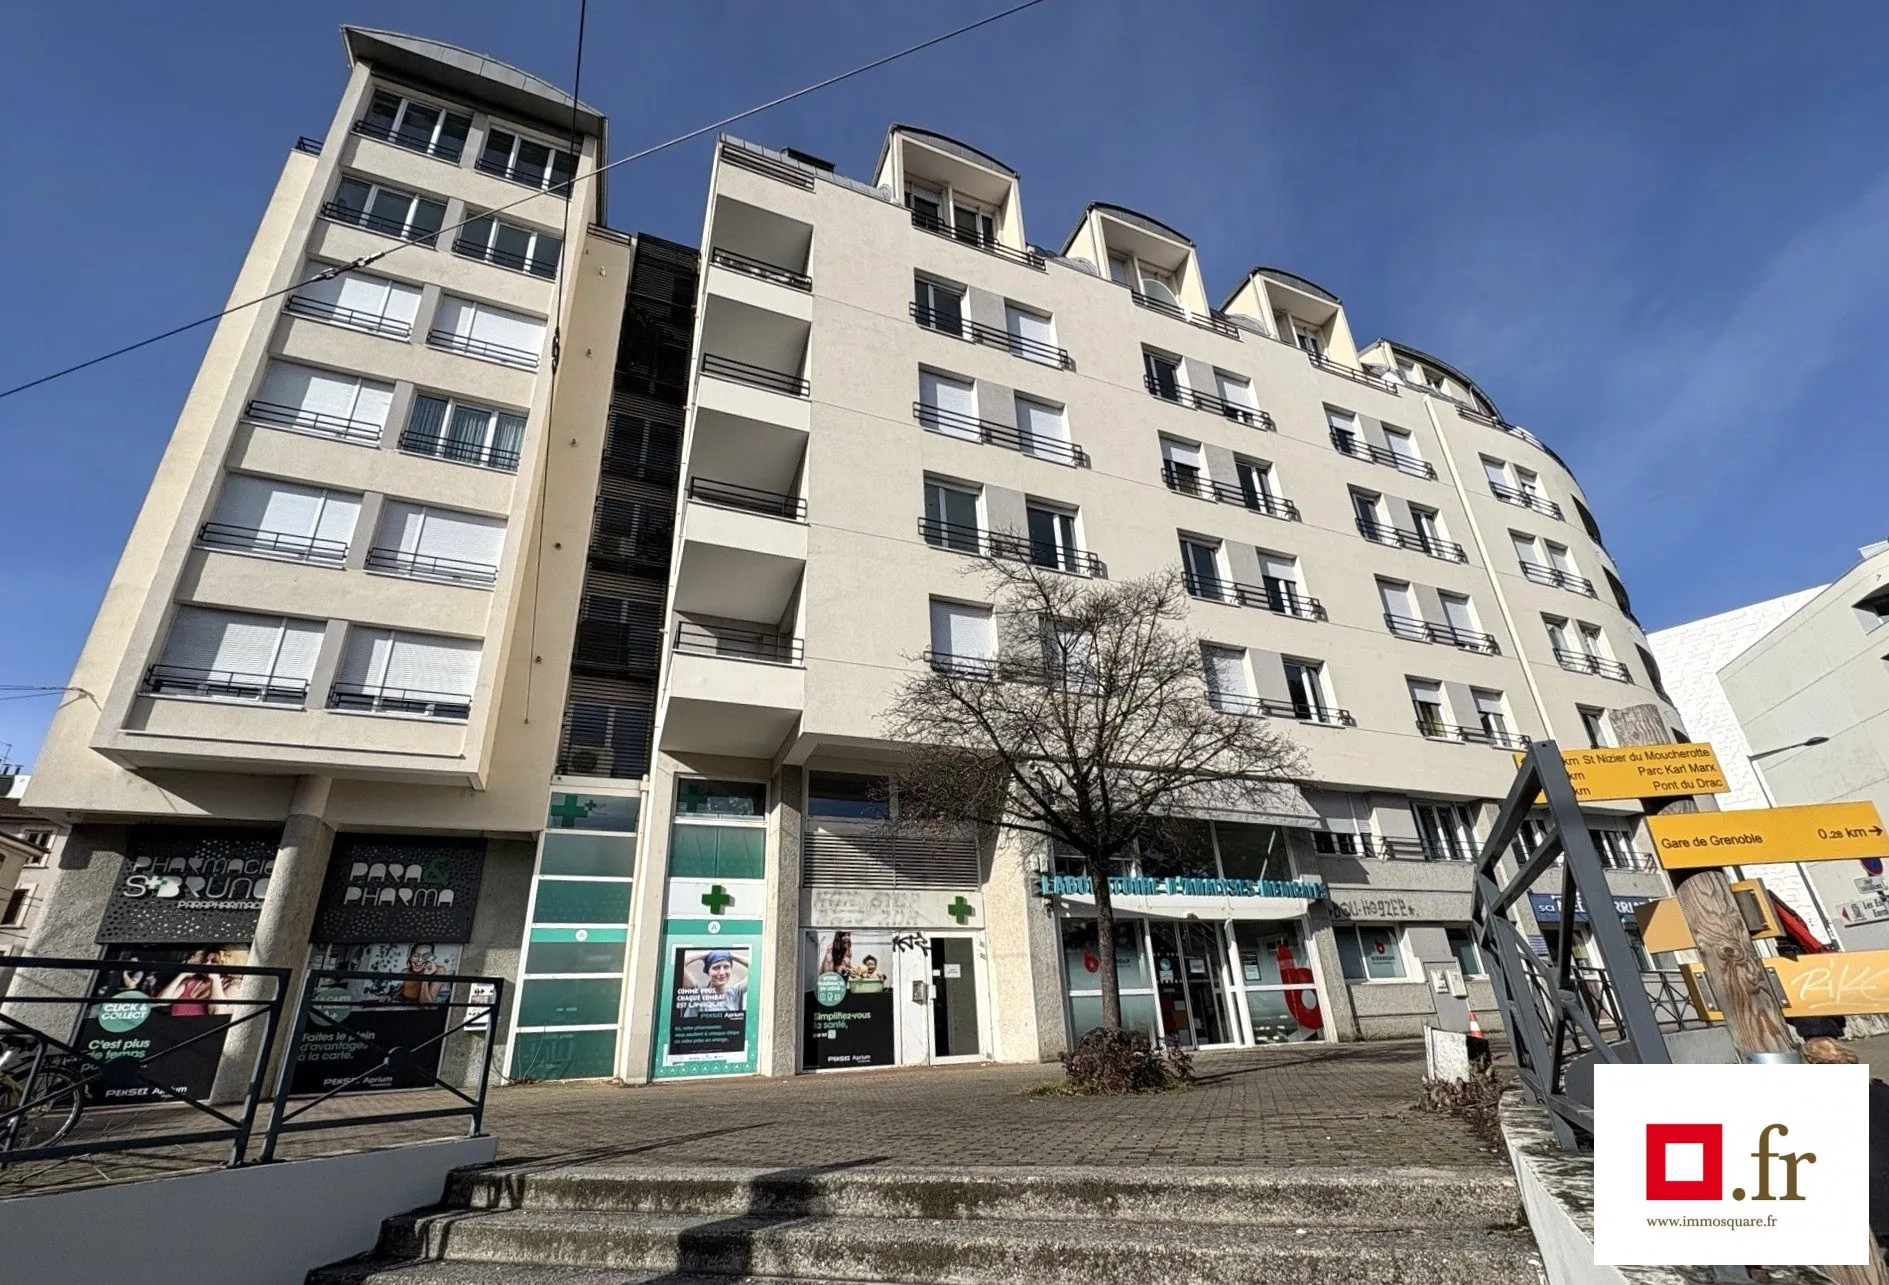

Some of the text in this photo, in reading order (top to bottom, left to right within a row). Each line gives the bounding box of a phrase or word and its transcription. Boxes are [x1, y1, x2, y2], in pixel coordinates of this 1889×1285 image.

[1582, 755, 1597, 765] St
[1597, 753, 1626, 764] Nizier
[1629, 752, 1643, 762] du
[1646, 749, 1710, 761] Moucherotte
[1637, 766, 1663, 776] Parc
[1665, 764, 1687, 775] Karl
[1690, 763, 1717, 774] Marx
[1653, 780, 1678, 791] Pont
[1681, 779, 1695, 789] du
[1698, 778, 1723, 788] Drac
[1661, 838, 1690, 849] Gare
[1692, 837, 1708, 847] de
[1709, 833, 1763, 846] Grenoble
[1844, 827, 1867, 838] km
[350, 862, 423, 883] PARA
[343, 886, 455, 907] PHARMA
[103, 1003, 149, 1012] CLICK &
[101, 1011, 147, 1020] COLLECT
[302, 1032, 335, 1041] Faites
[336, 1032, 347, 1041] le
[88, 1039, 151, 1050] C'est plus
[308, 1052, 319, 1060] la
[105, 1087, 149, 1097] PENSEZ
